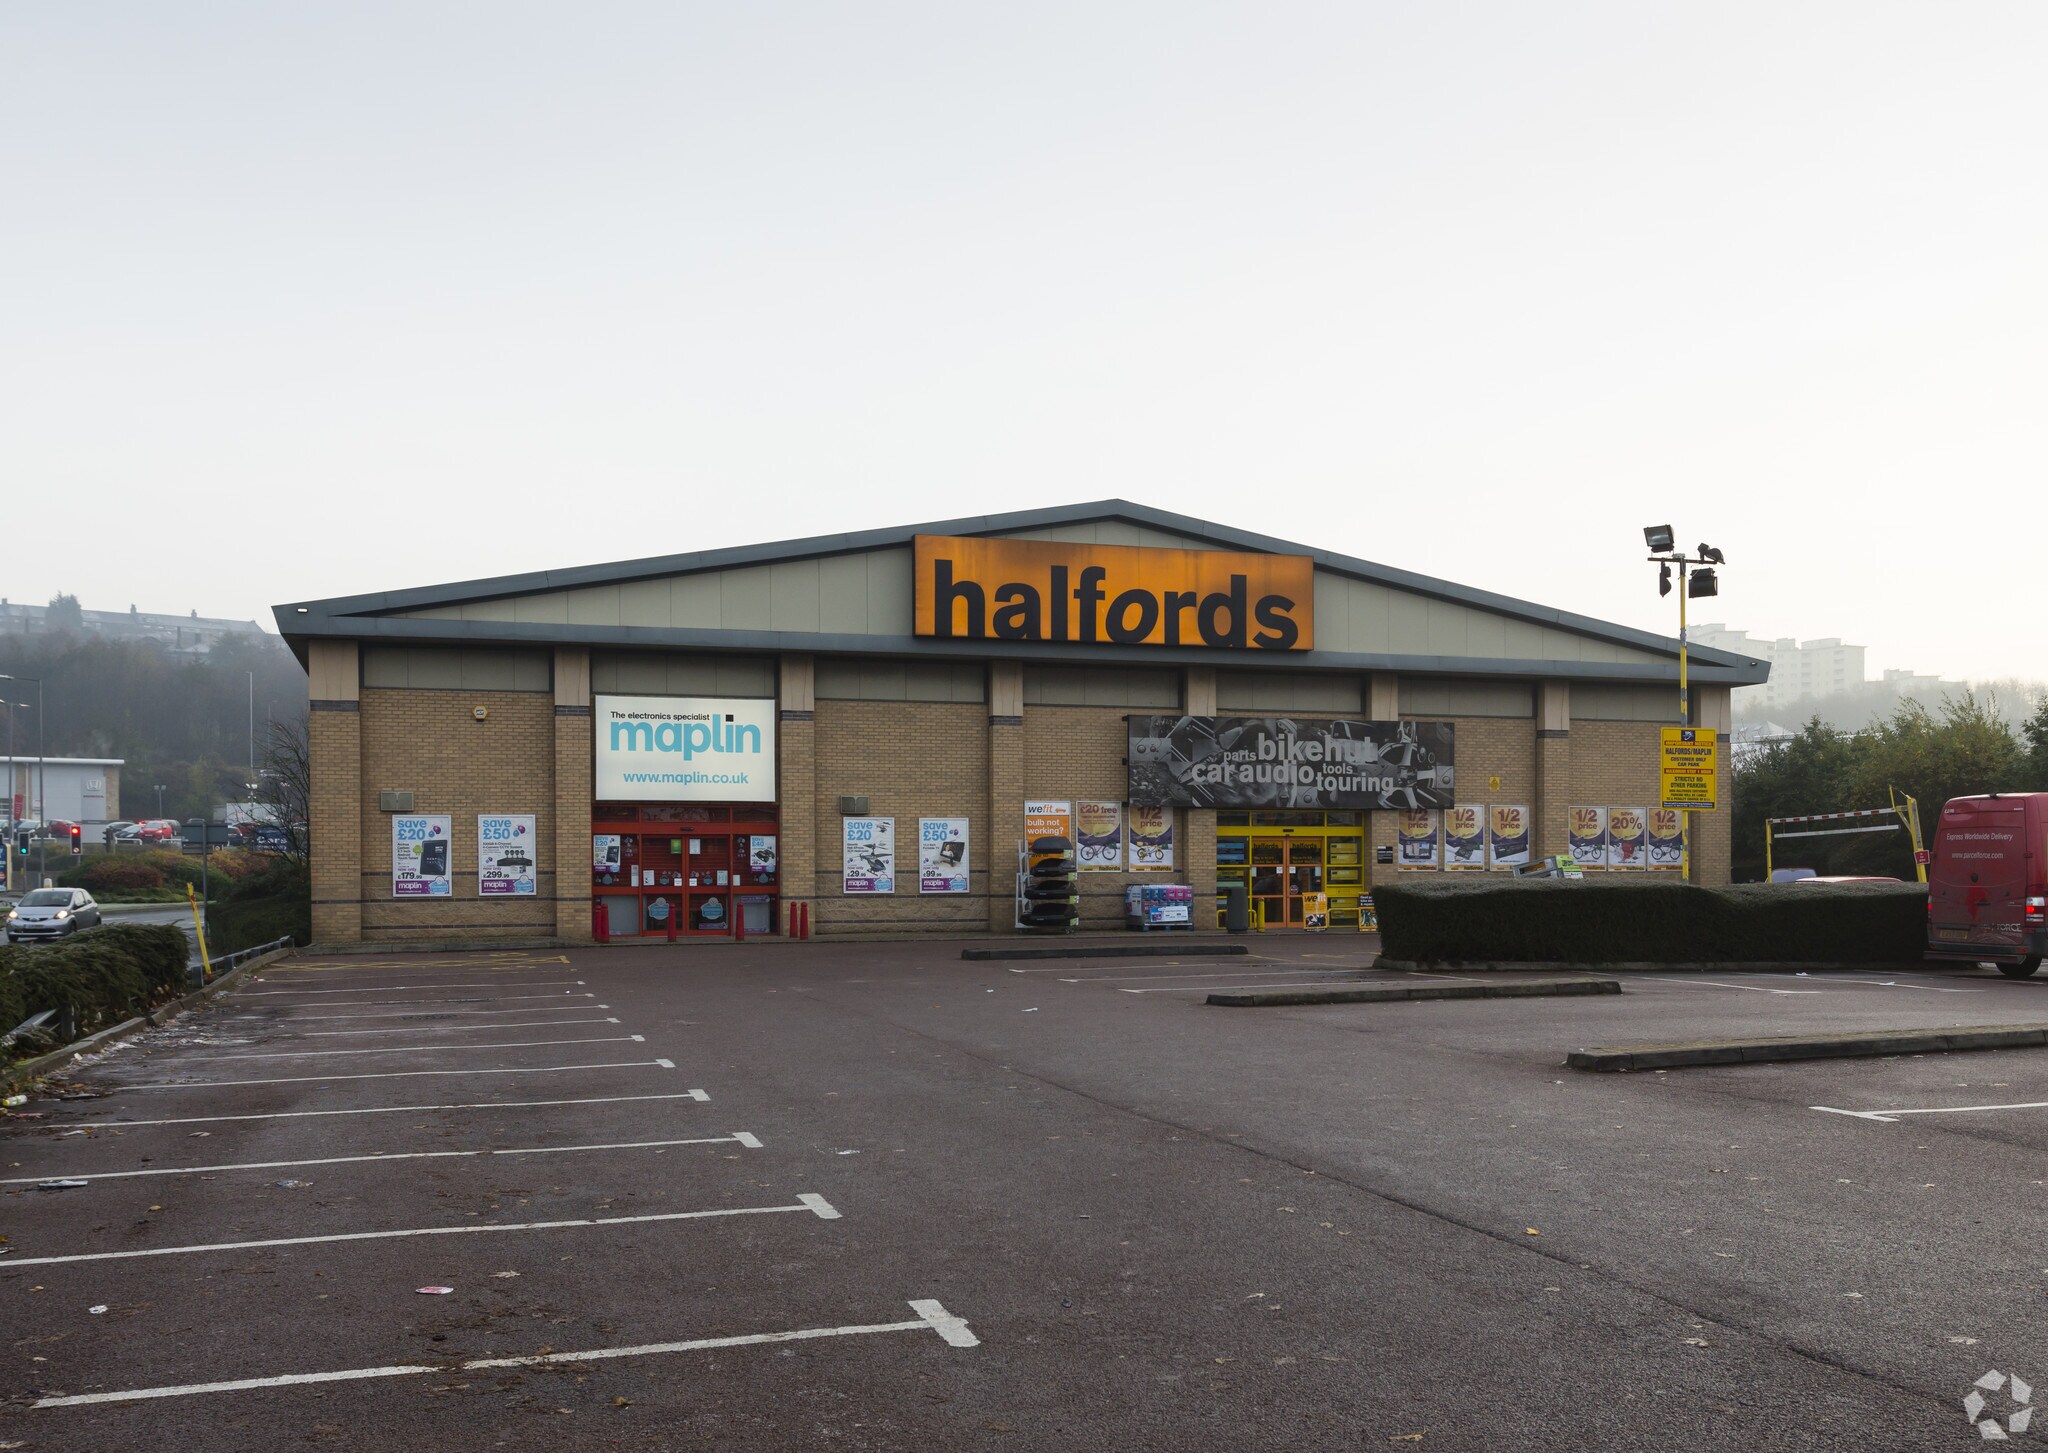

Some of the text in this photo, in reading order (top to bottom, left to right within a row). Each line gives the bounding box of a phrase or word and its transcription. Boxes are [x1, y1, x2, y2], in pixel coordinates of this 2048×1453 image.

[935, 559, 1299, 650] halfords
[611, 711, 710, 721] The electronics specialist
[611, 714, 760, 761] maplin
[1224, 733, 1382, 767] parts bikehut
[1665, 747, 1712, 755] HALFORDS/MAPLIN
[1191, 759, 1315, 783] car audio
[1322, 763, 1353, 775] tools
[623, 772, 749, 785] www.maplin.co.uk
[1316, 773, 1393, 796] touring
[1028, 803, 1053, 813] wefit
[1080, 804, 1118, 814] £20 free
[1138, 806, 1162, 820] 1/2
[1407, 808, 1428, 822] 1/2
[1454, 808, 1475, 822] 1/2
[1498, 808, 1521, 822] 1/2
[1576, 809, 1598, 823] 1/2
[1655, 810, 1676, 823] 1/2
[397, 820, 427, 828] save
[483, 820, 511, 828] save
[847, 821, 873, 829] save
[923, 822, 948, 830] save
[1140, 820, 1163, 828] price
[1408, 821, 1428, 830] price
[1455, 821, 1475, 830] price
[1500, 821, 1521, 830] price
[1578, 822, 1598, 831] price
[1611, 816, 1642, 830] 20%
[1657, 822, 1676, 831] price
[398, 829, 426, 840] £20
[483, 828, 511, 840] £50
[847, 830, 871, 841] £20
[923, 831, 947, 841] £50
[1027, 827, 1064, 836] working?
[1946, 832, 2013, 842] Express Worldwide Delivery
[1951, 852, 2003, 860] www.parcelforce.com
[398, 882, 422, 890] maplin
[483, 881, 507, 889] maplin
[847, 879, 868, 887] maplin
[923, 879, 944, 887] maplin
